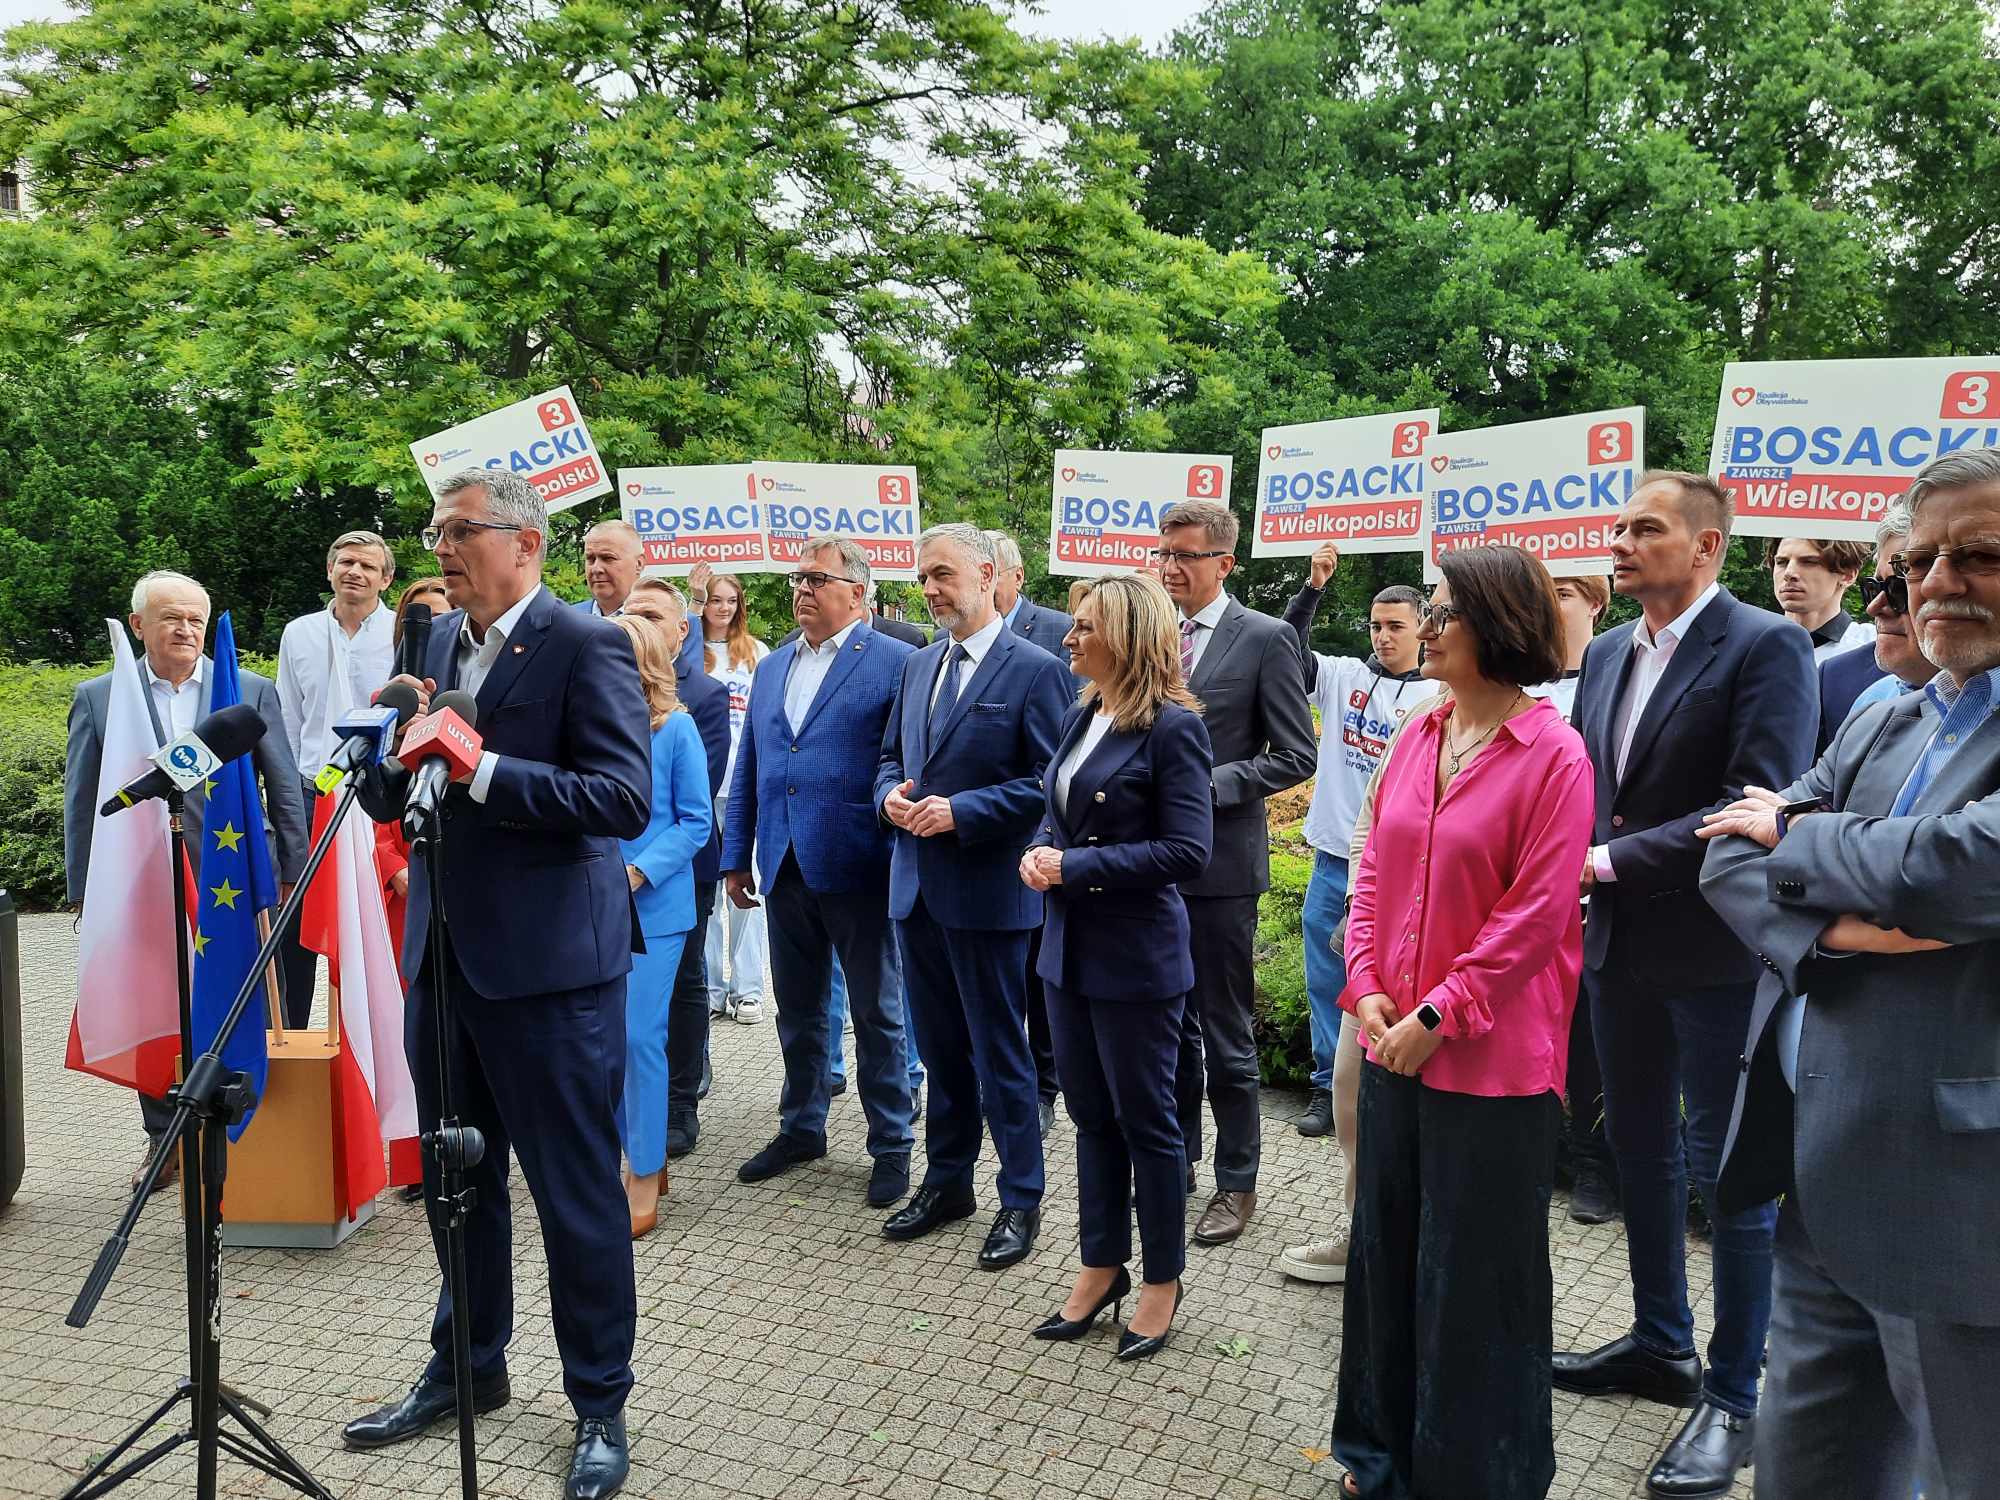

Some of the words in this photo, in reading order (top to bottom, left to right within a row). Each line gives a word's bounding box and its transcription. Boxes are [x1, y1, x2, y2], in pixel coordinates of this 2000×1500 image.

[1957, 376, 1990, 415] 3
[545, 402, 566, 426] 3
[485, 426, 588, 473] ACKI
[1401, 425, 1419, 454] 3
[1599, 426, 1621, 460] 3
[534, 462, 596, 497] polski
[1196, 468, 1214, 495] 3
[1268, 462, 1423, 504] BOSACKI
[1731, 467, 1787, 479] ZAWSZE
[886, 478, 902, 503] 3
[1438, 468, 1633, 522] BOSACKI
[1745, 481, 1900, 520] Wielkop
[634, 504, 760, 533] BOSAC
[768, 503, 913, 535] BOSACKI
[1063, 496, 1178, 529] BOSA
[1263, 521, 1274, 536] z
[1278, 506, 1418, 538] Wielkopolski
[1269, 504, 1303, 514] ZAWSZE
[1065, 526, 1101, 536] ZAWSZE
[1440, 522, 1483, 535] ZAWSZE
[1453, 524, 1614, 559] Wilkopolsk
[649, 540, 762, 562] Wielkopols
[771, 543, 781, 556] z
[1060, 541, 1071, 556] z
[1074, 538, 1160, 567] Wielkop
[1352, 691, 1363, 706] 3
[174, 747, 193, 767] tvn
